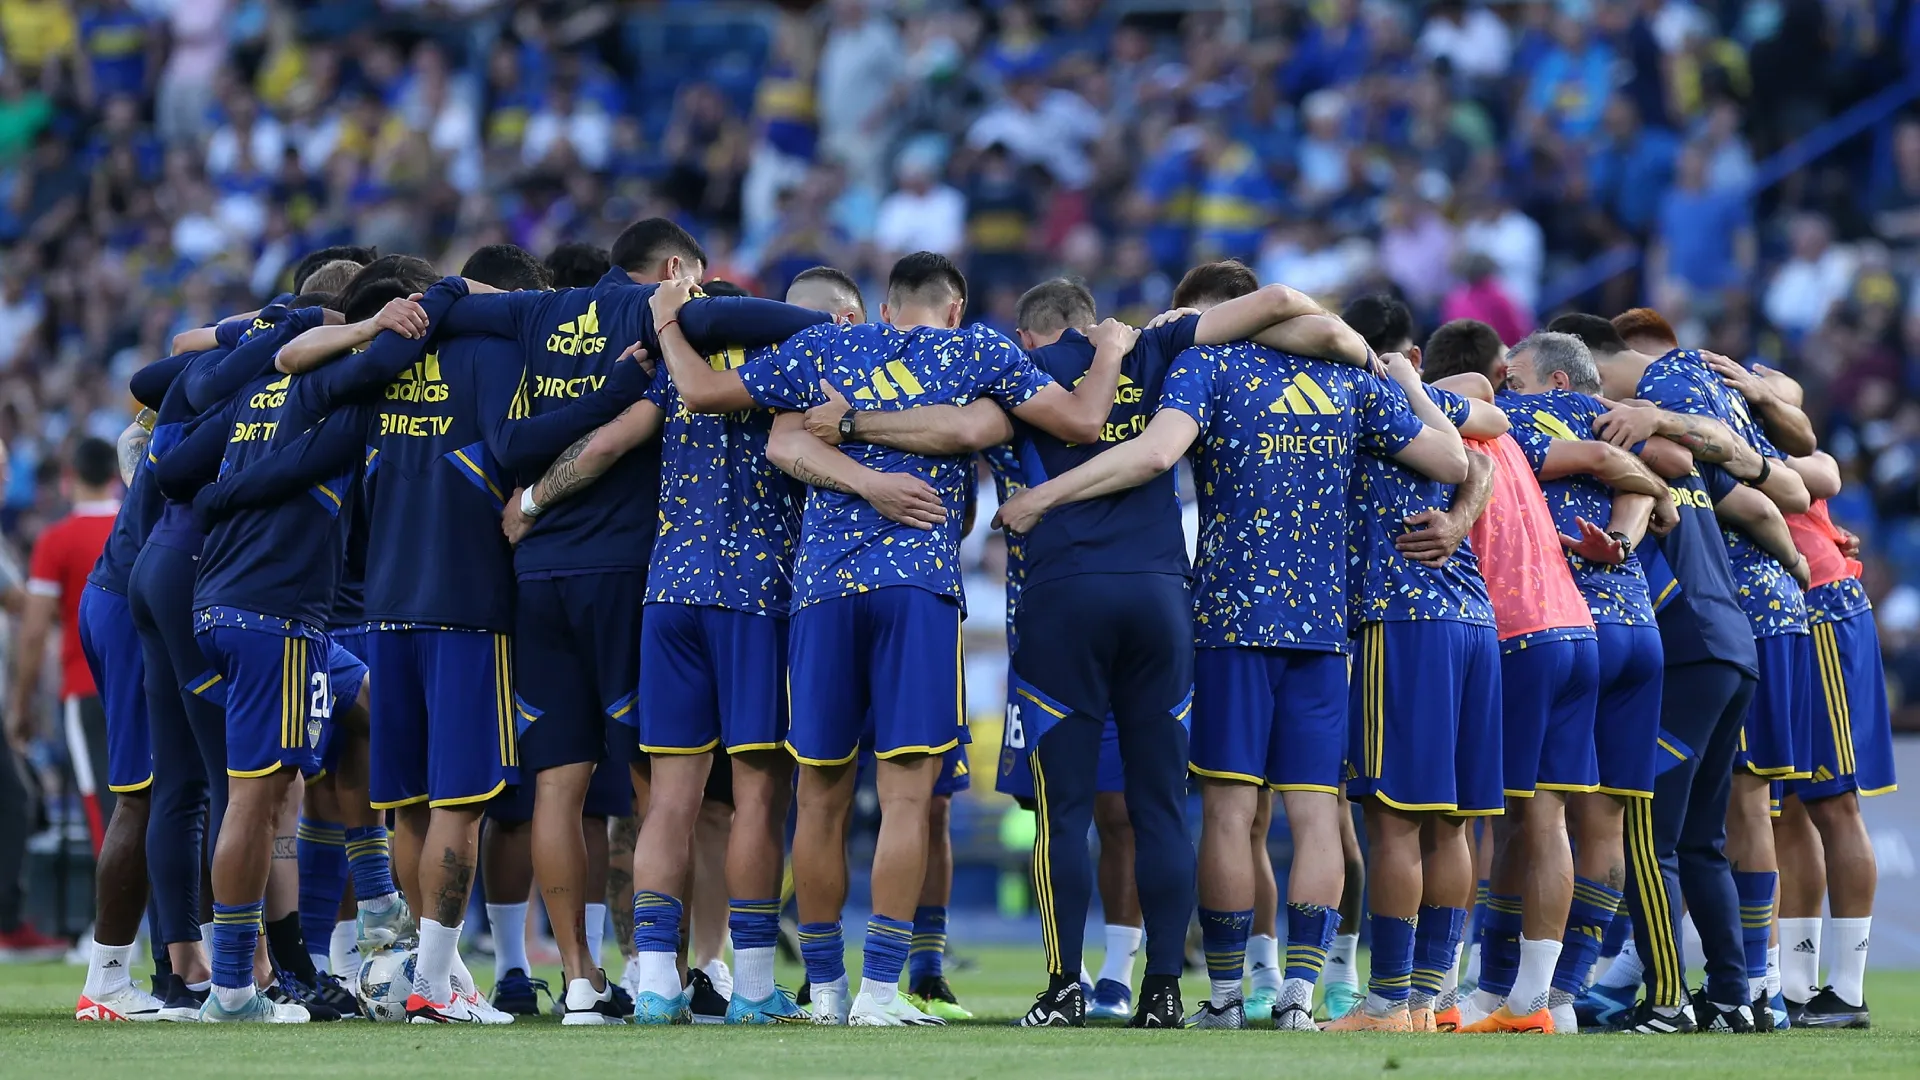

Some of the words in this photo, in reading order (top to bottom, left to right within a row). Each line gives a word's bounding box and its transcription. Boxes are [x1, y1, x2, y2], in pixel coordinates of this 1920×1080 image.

[379, 413, 454, 437] DIRECTV
[1257, 433, 1348, 455] DIRECTV
[1166, 994, 1174, 1016] COPA
